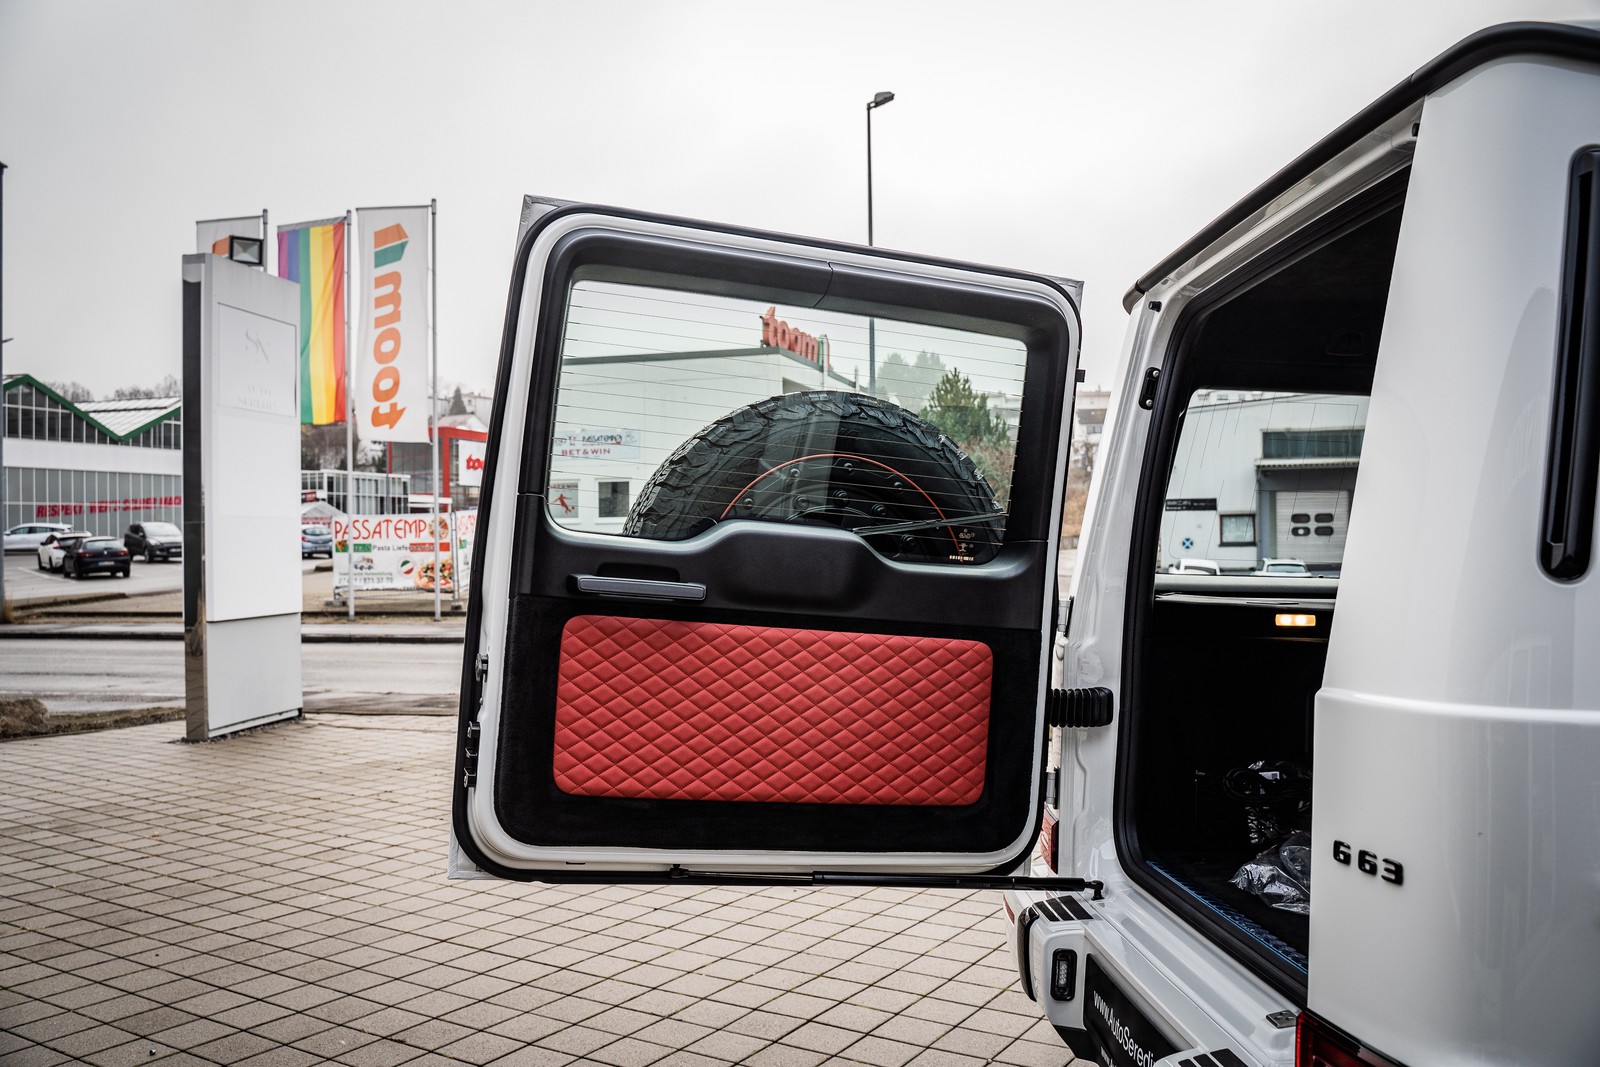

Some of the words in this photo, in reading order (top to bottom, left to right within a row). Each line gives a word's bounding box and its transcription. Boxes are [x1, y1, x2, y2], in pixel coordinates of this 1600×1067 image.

[371, 271, 407, 429] toom
[762, 306, 819, 364] toom
[1094, 991, 1156, 1067] www.AutoSeredi
